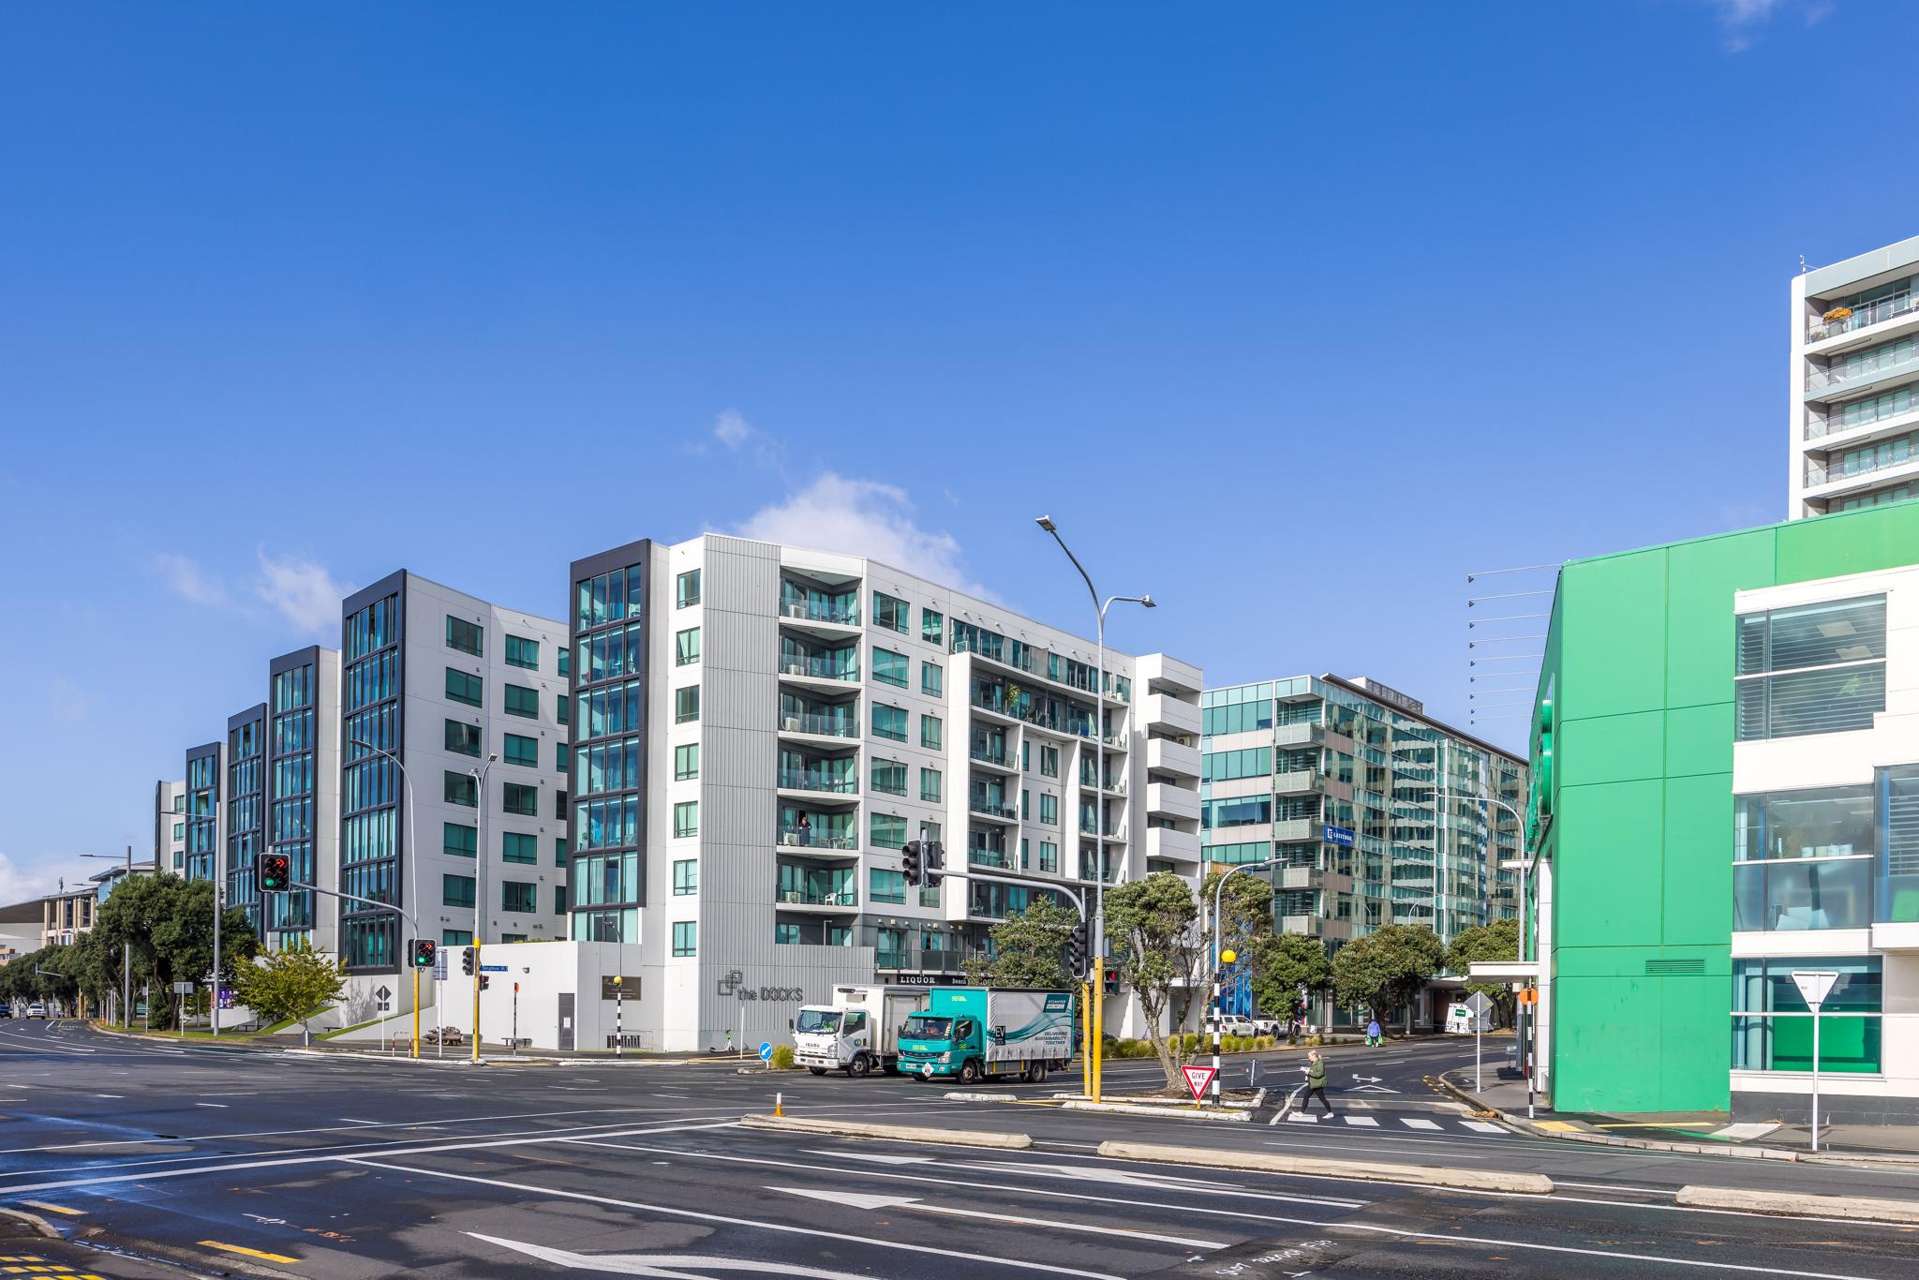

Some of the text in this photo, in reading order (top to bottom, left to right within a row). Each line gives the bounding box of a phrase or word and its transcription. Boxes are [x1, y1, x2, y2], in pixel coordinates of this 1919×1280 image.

[900, 976, 936, 984] LIQUOR
[737, 986, 804, 1002] the DOCKS
[995, 1026, 1005, 1037] EV
[1191, 1071, 1206, 1080] GIVE
